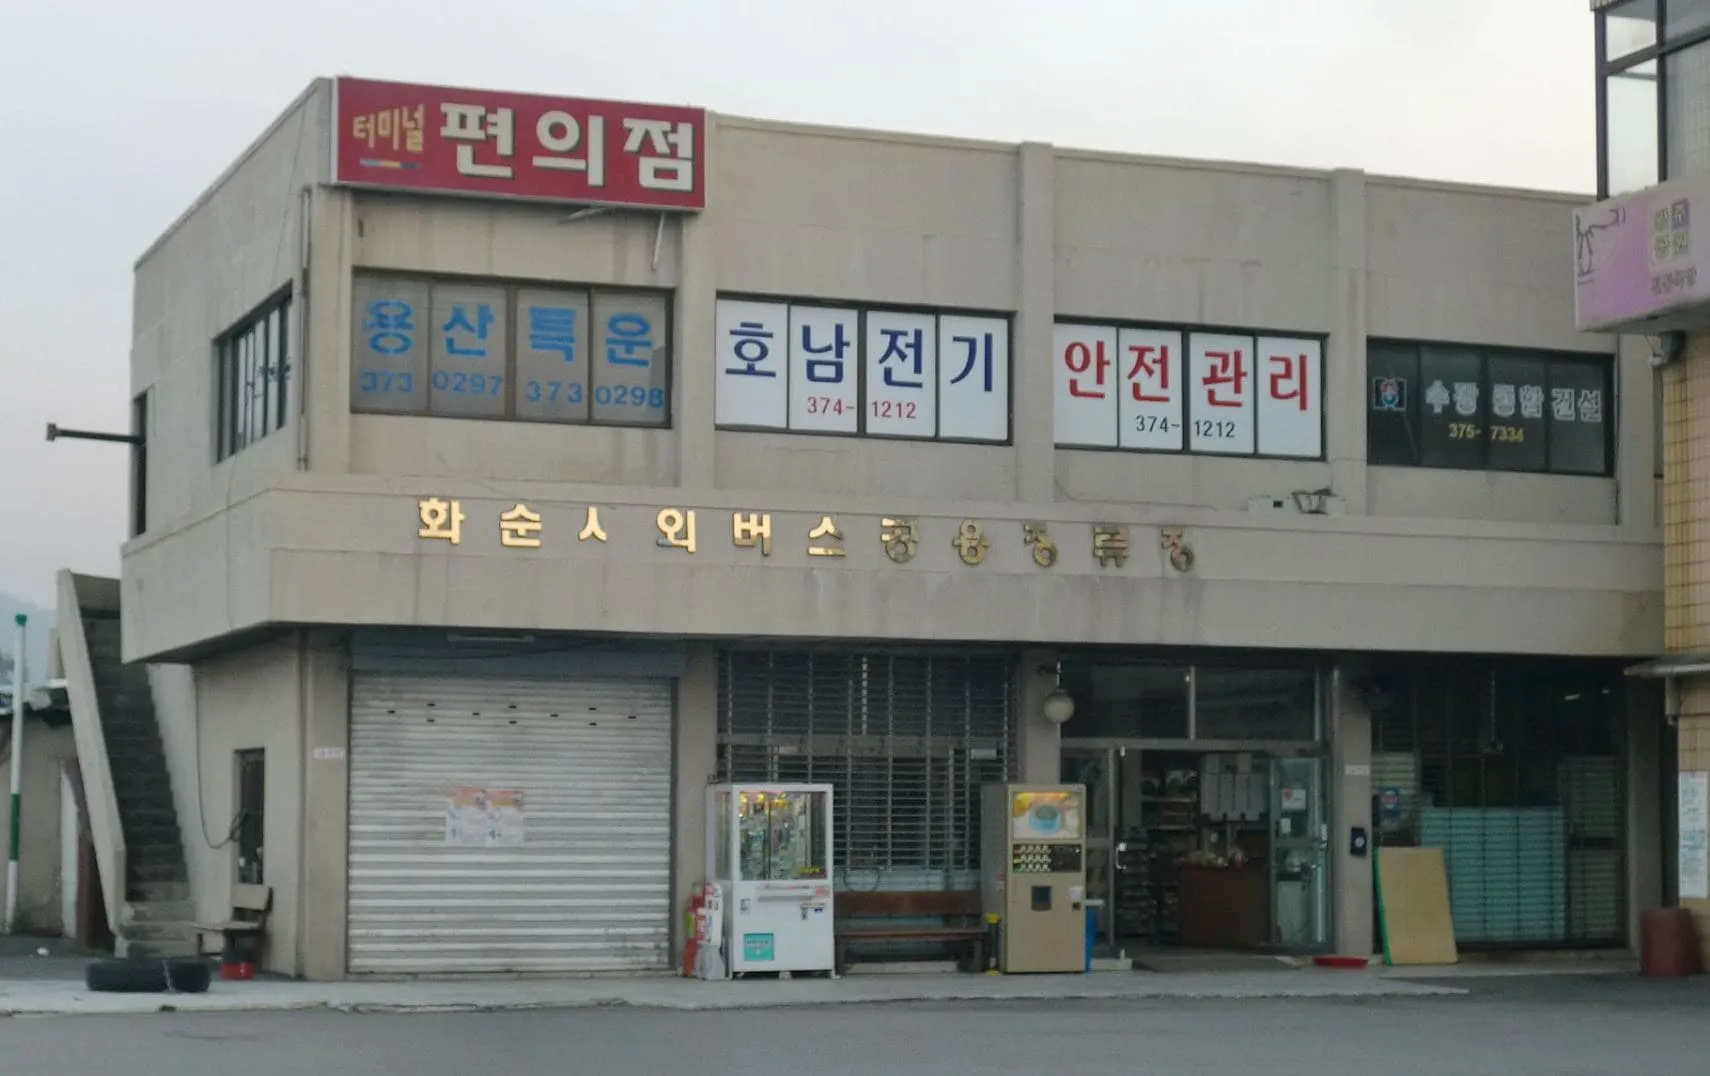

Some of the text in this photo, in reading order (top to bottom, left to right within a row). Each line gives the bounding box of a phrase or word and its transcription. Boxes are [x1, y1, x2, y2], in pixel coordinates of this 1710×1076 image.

[352, 102, 694, 192] 터미널 편의점
[360, 370, 666, 410] 373 0297 373 0298
[725, 321, 994, 393] 호남전기
[1063, 340, 1309, 411] 안전관리
